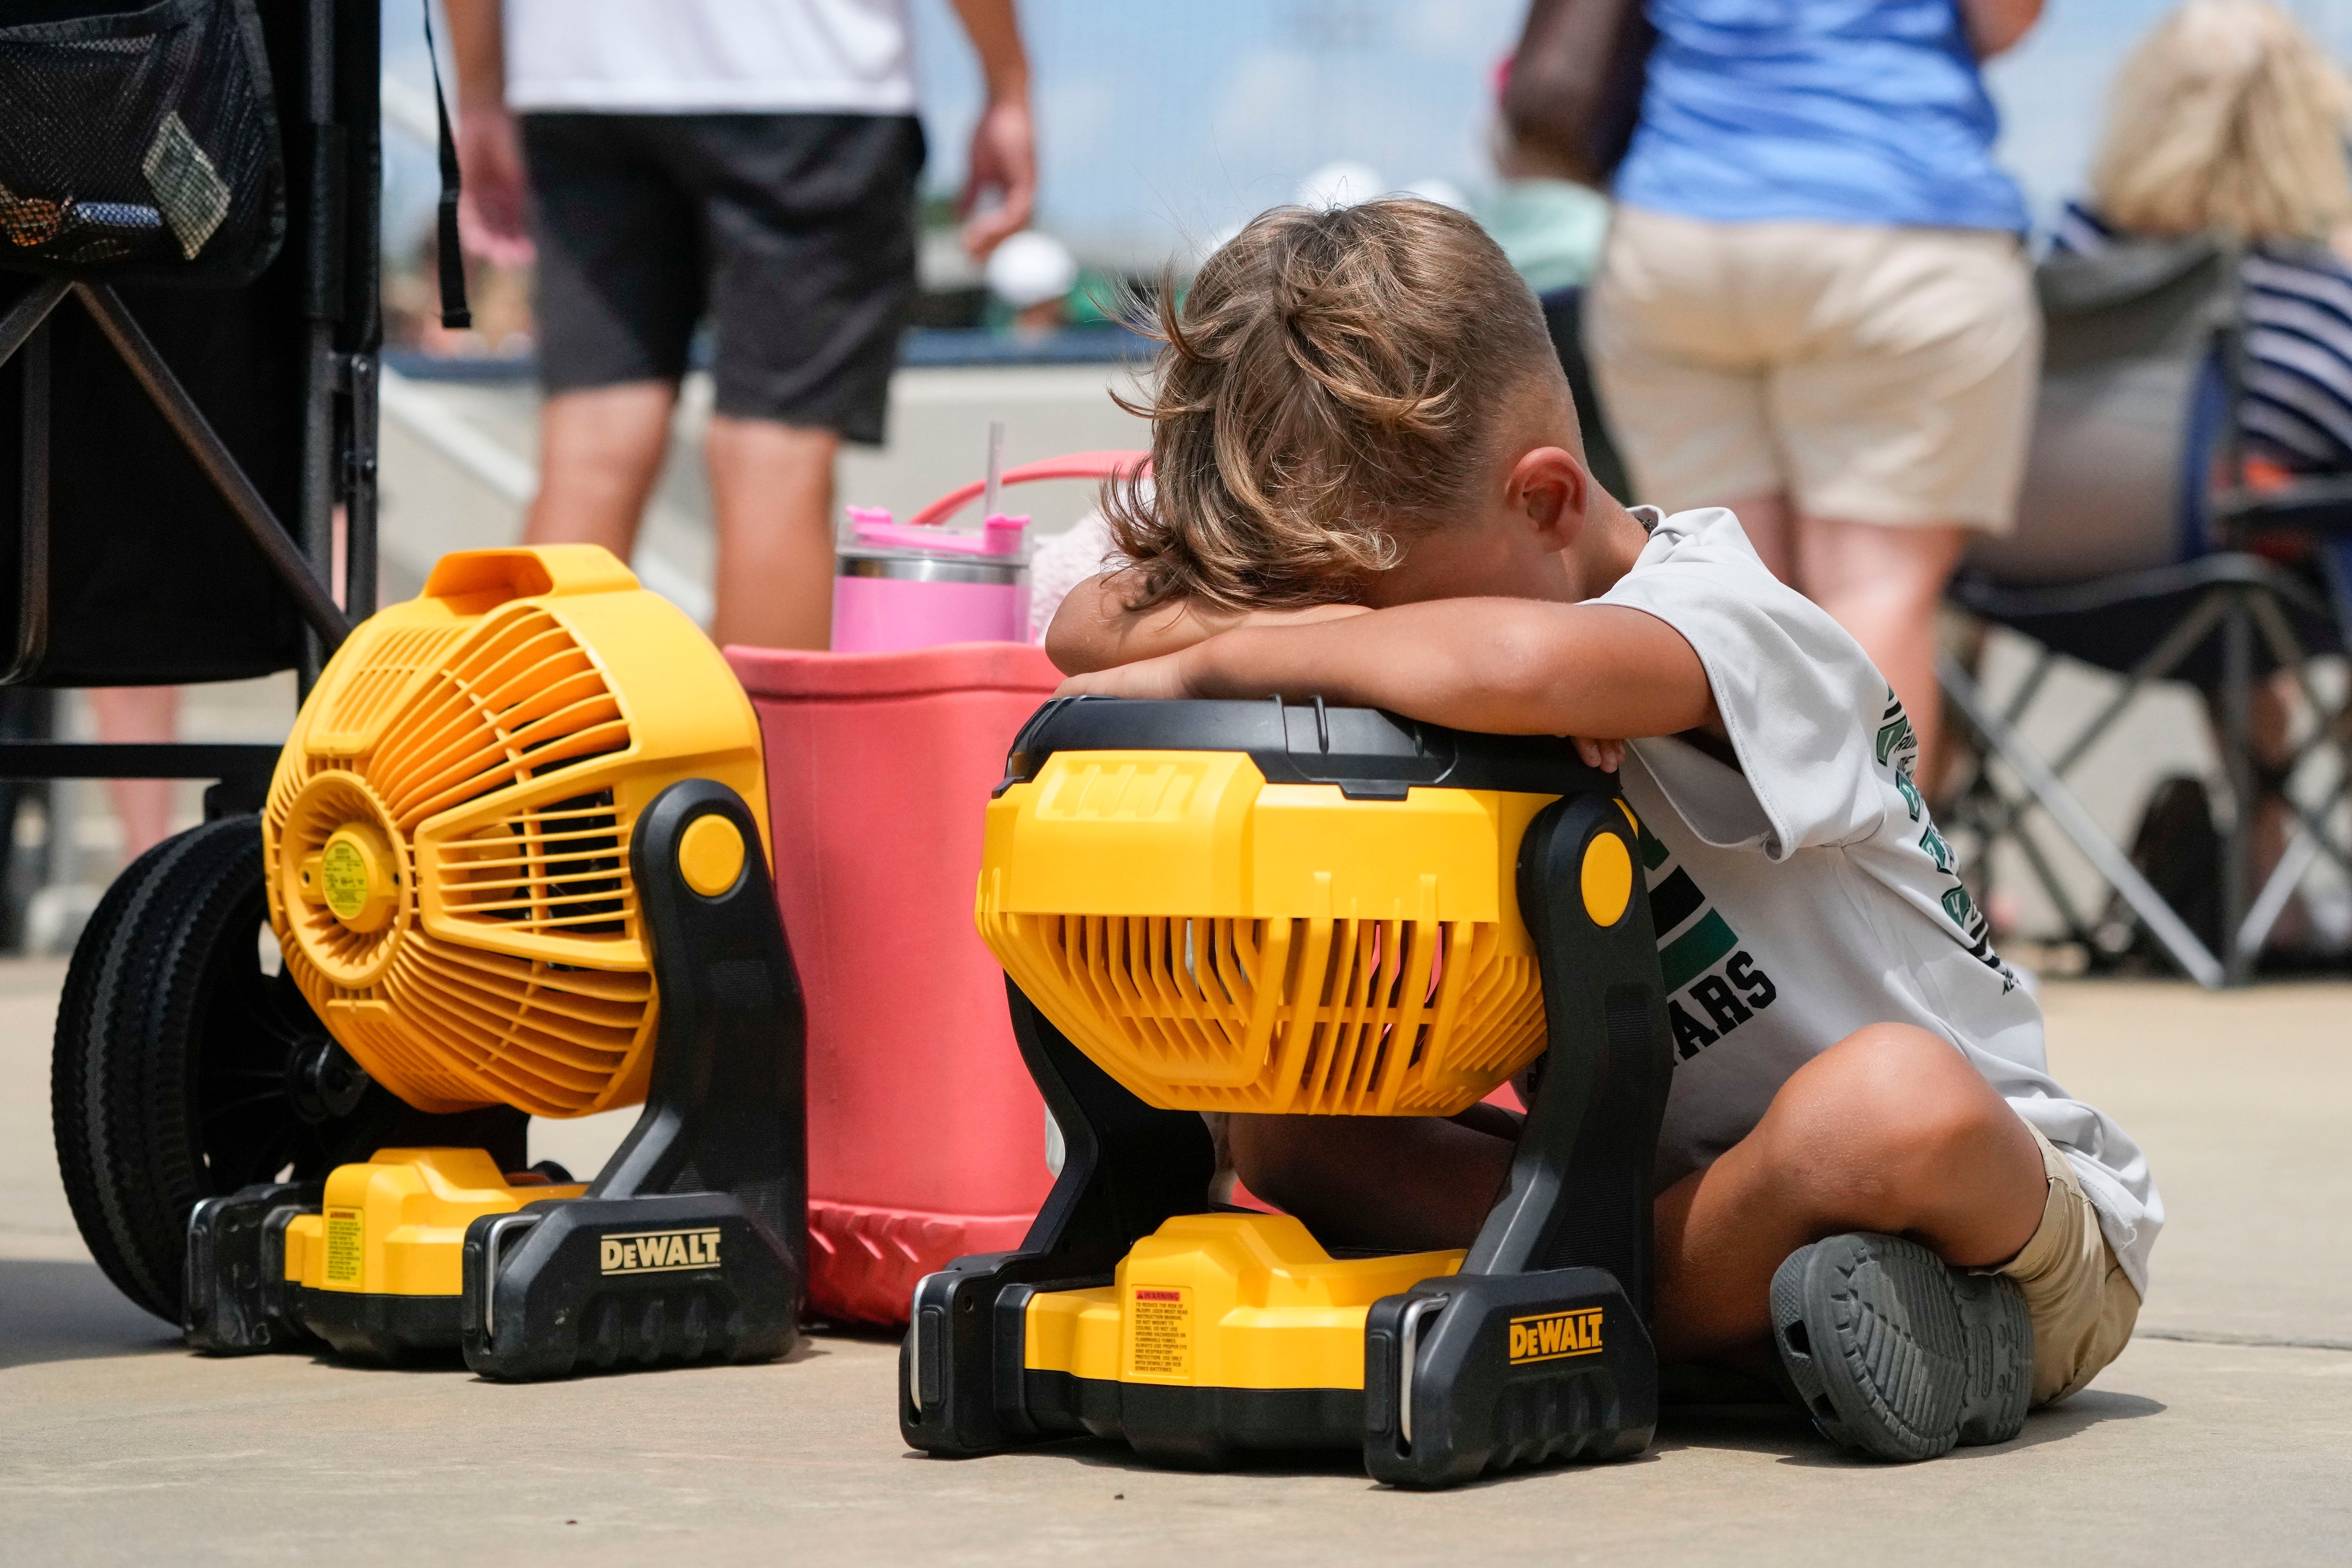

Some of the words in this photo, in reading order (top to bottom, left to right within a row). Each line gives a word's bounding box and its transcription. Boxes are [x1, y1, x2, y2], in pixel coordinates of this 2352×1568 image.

[1667, 950, 1777, 1067] ARS
[601, 1233, 721, 1270] DEWALT
[1510, 1313, 1602, 1359] DEWALT
